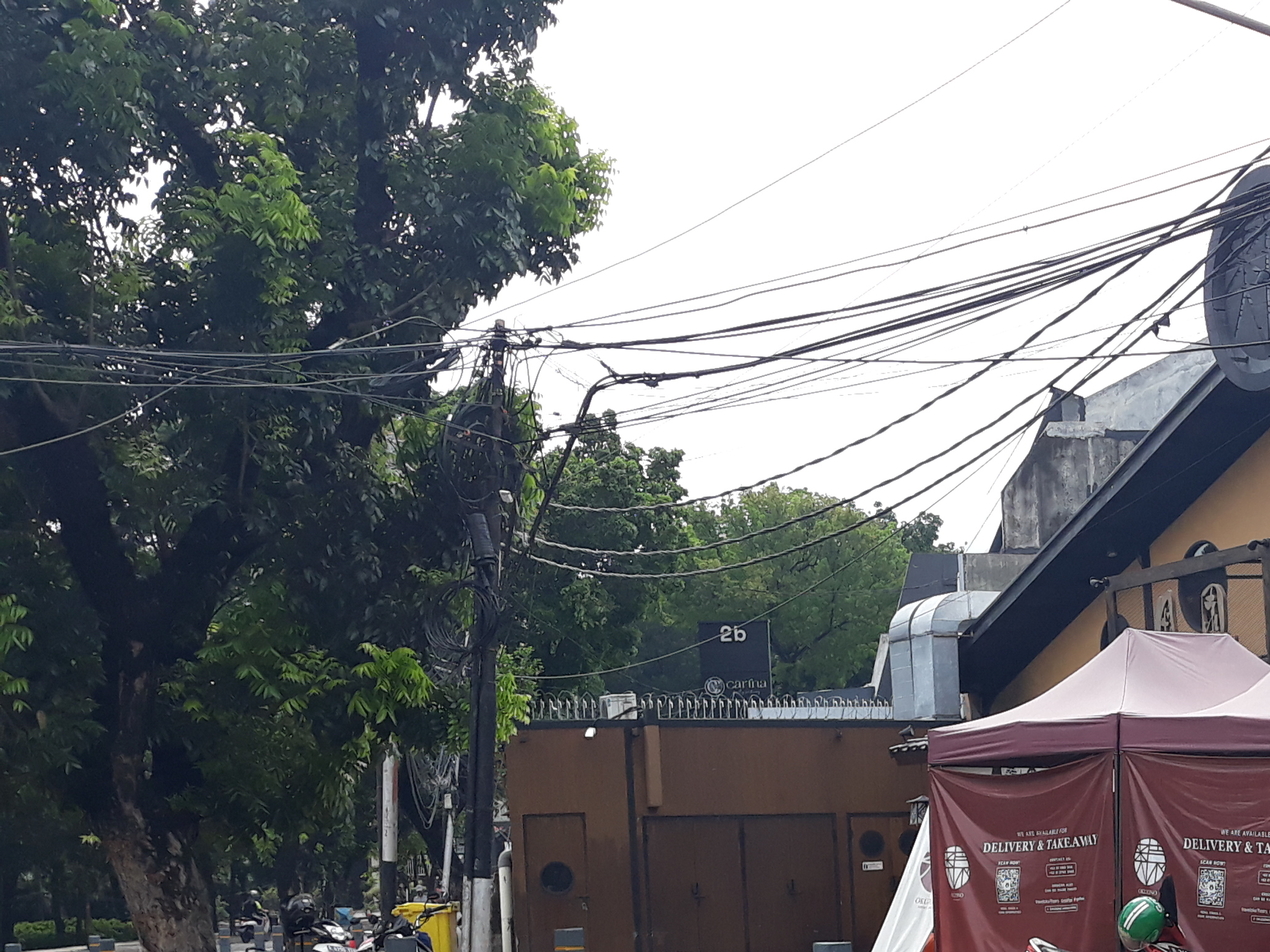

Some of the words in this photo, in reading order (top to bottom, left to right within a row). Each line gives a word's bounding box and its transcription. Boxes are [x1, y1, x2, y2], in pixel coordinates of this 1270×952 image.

[719, 625, 747, 643] 2b
[1220, 829, 1230, 837] WE
[1230, 830, 1241, 838] ARE
[983, 840, 1036, 854] DELIVERY
[1037, 840, 1045, 851] &
[1046, 833, 1099, 851] TAKEAWAY
[1183, 837, 1242, 854] DELIVERY
[1243, 842, 1253, 854] &
